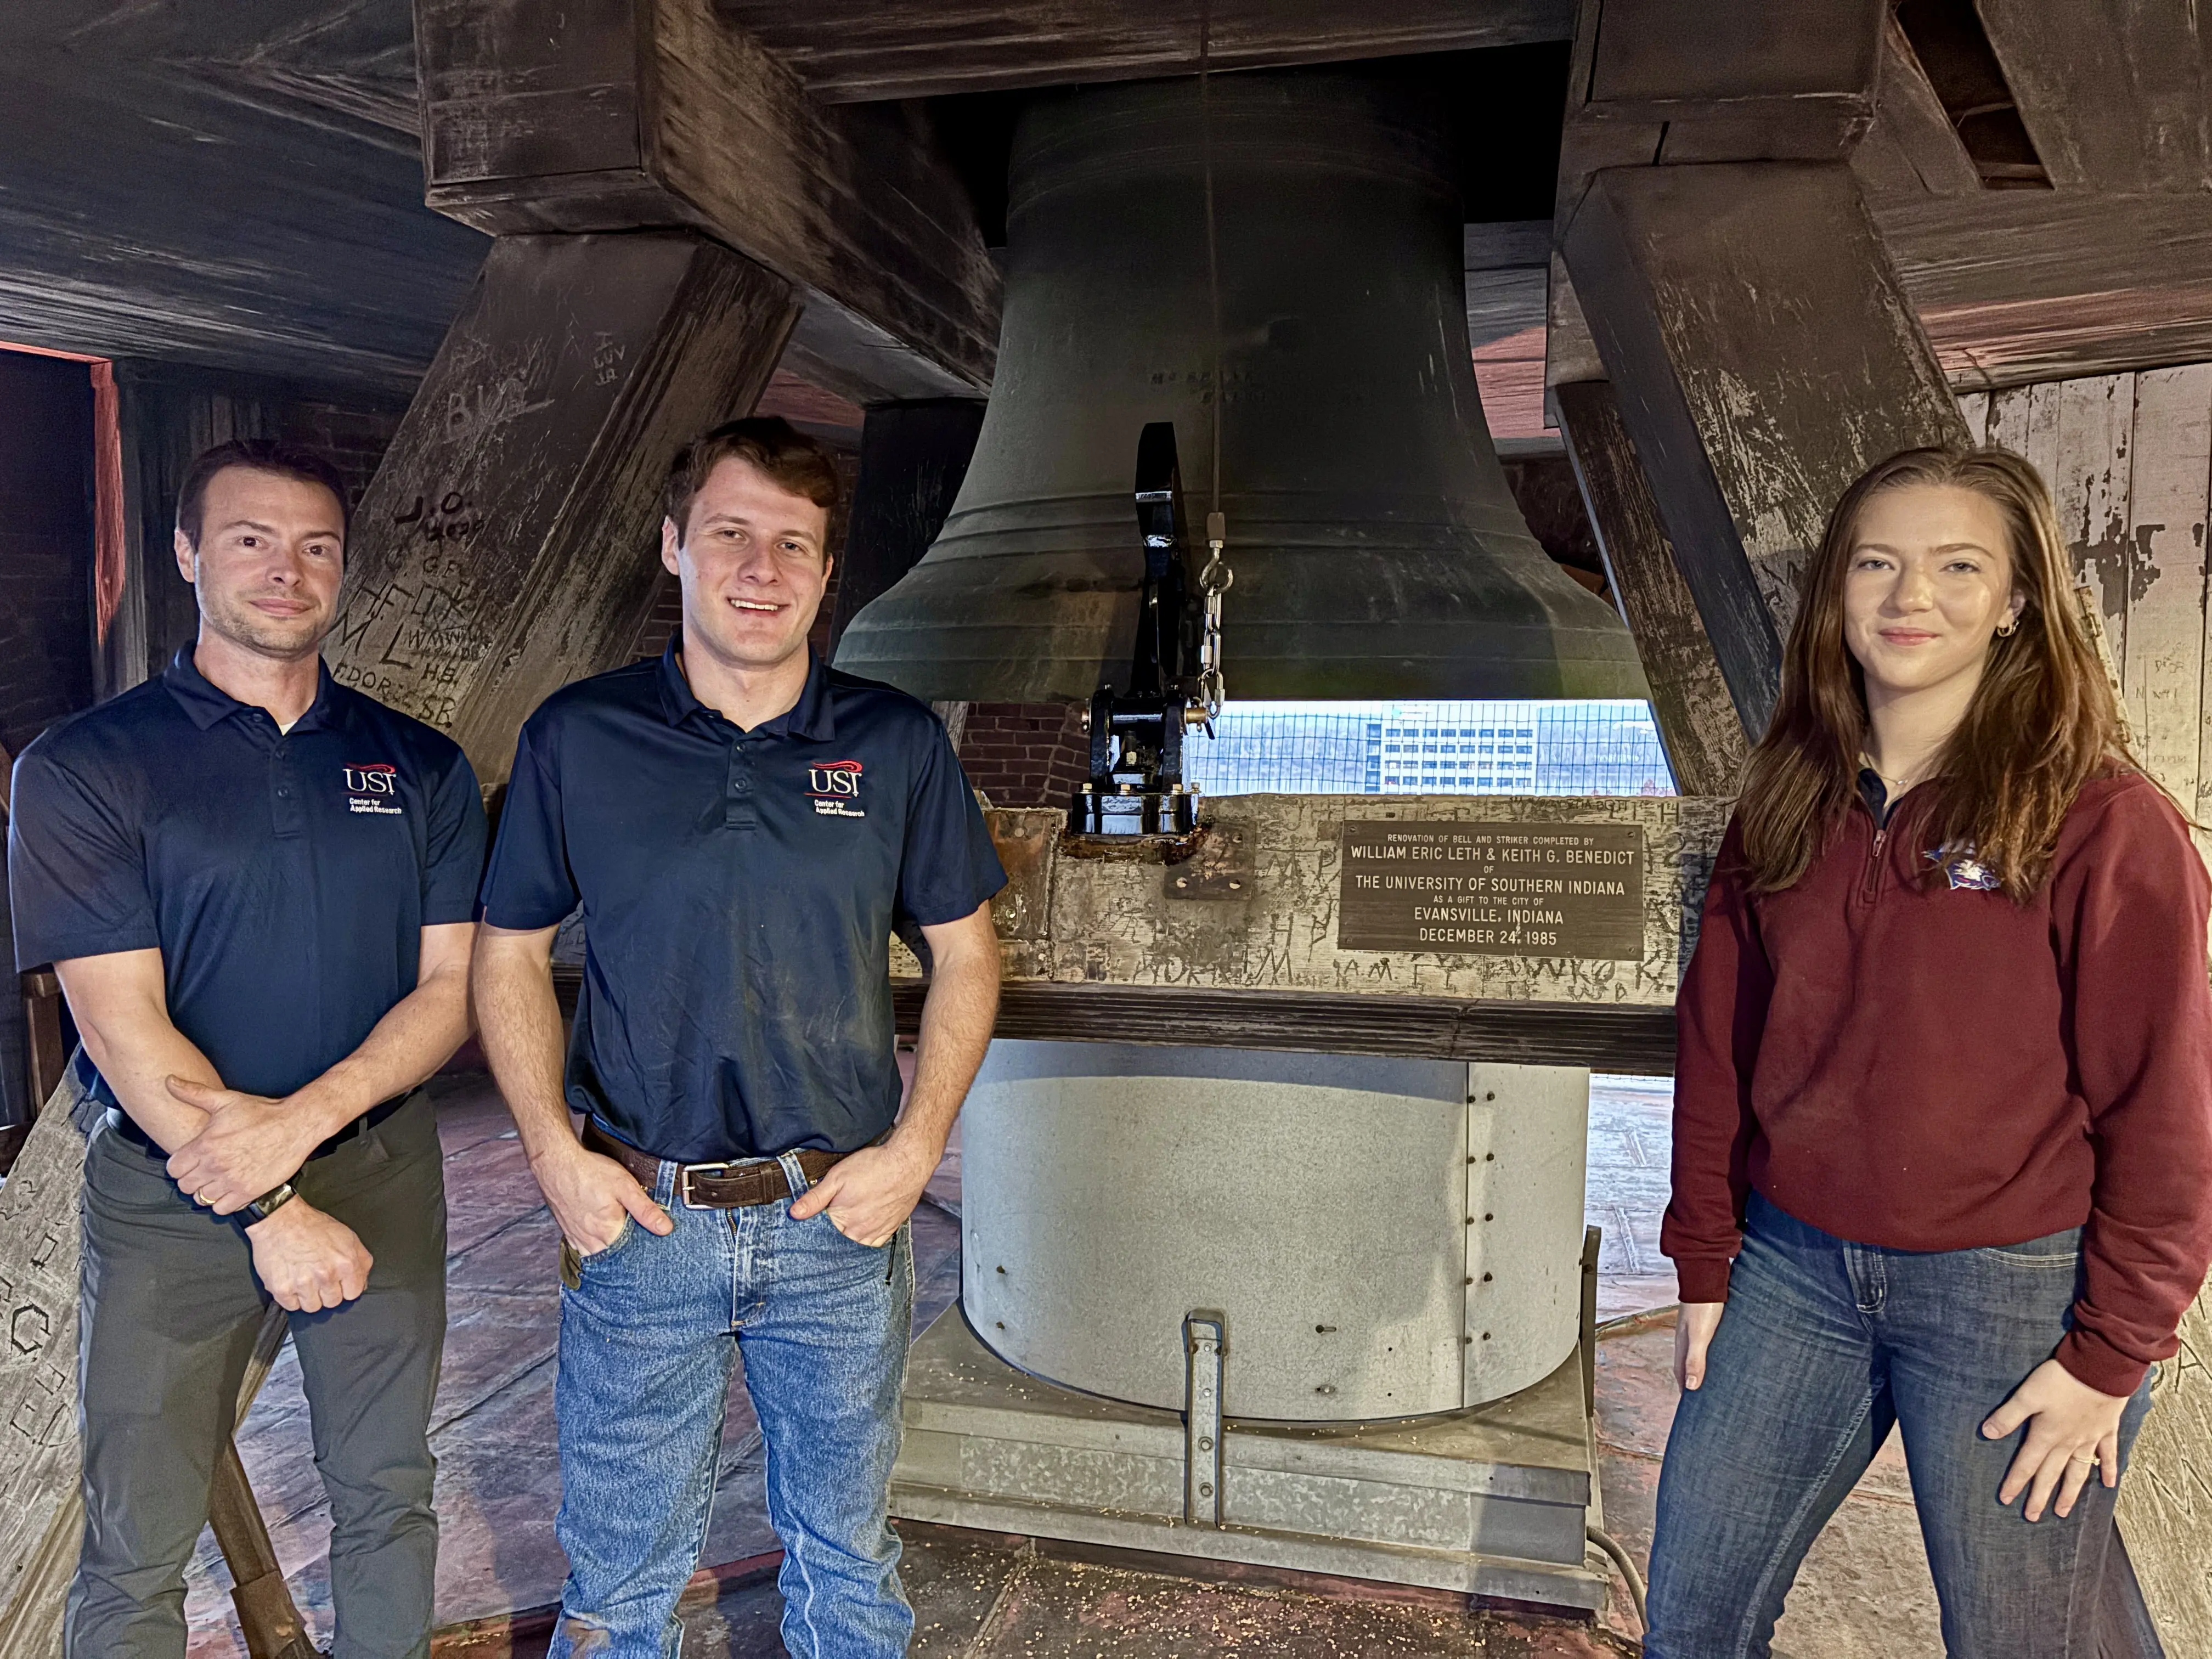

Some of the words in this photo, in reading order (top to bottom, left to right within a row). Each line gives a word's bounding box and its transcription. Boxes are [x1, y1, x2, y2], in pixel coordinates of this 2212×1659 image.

[342, 769, 397, 795] USI
[808, 769, 862, 797] USI
[350, 805, 374, 813] Applied
[374, 806, 402, 814] Research
[814, 799, 834, 808] Center
[1387, 834, 1434, 843] RENOVATION
[1453, 835, 1472, 843] BELL
[1476, 836, 1492, 844] AND
[1496, 836, 1528, 844] STRIKER
[1533, 836, 1579, 845] COMPLETED
[1584, 837, 1594, 845] BY
[1351, 845, 1406, 860] WILLIAM
[1412, 847, 1442, 860] ERIC
[1448, 847, 1480, 861] LETH
[1486, 847, 1496, 861] &
[1502, 848, 1541, 862] KEITH
[1547, 849, 1560, 863] G.
[1566, 850, 1634, 865] BENEDICT
[1483, 865, 1494, 873] OF
[1355, 875, 1380, 888] THE
[1386, 876, 1462, 890] UNIVERSITY
[1469, 877, 1486, 891] OF
[1491, 878, 1562, 893] SOUTHERN
[1568, 881, 1625, 895] INDIANA
[1434, 895, 1443, 903] AS
[1457, 895, 1475, 904] GIFT
[1479, 896, 1488, 905] TO
[1493, 896, 1507, 905] THE
[1512, 897, 1529, 905] CITY
[1533, 898, 1544, 906] OF
[1414, 907, 1502, 923] EVANSVILLE,
[1508, 909, 1564, 924] INDIANA
[1420, 928, 1494, 944] DECEMBER
[1526, 931, 1556, 946] 1985
